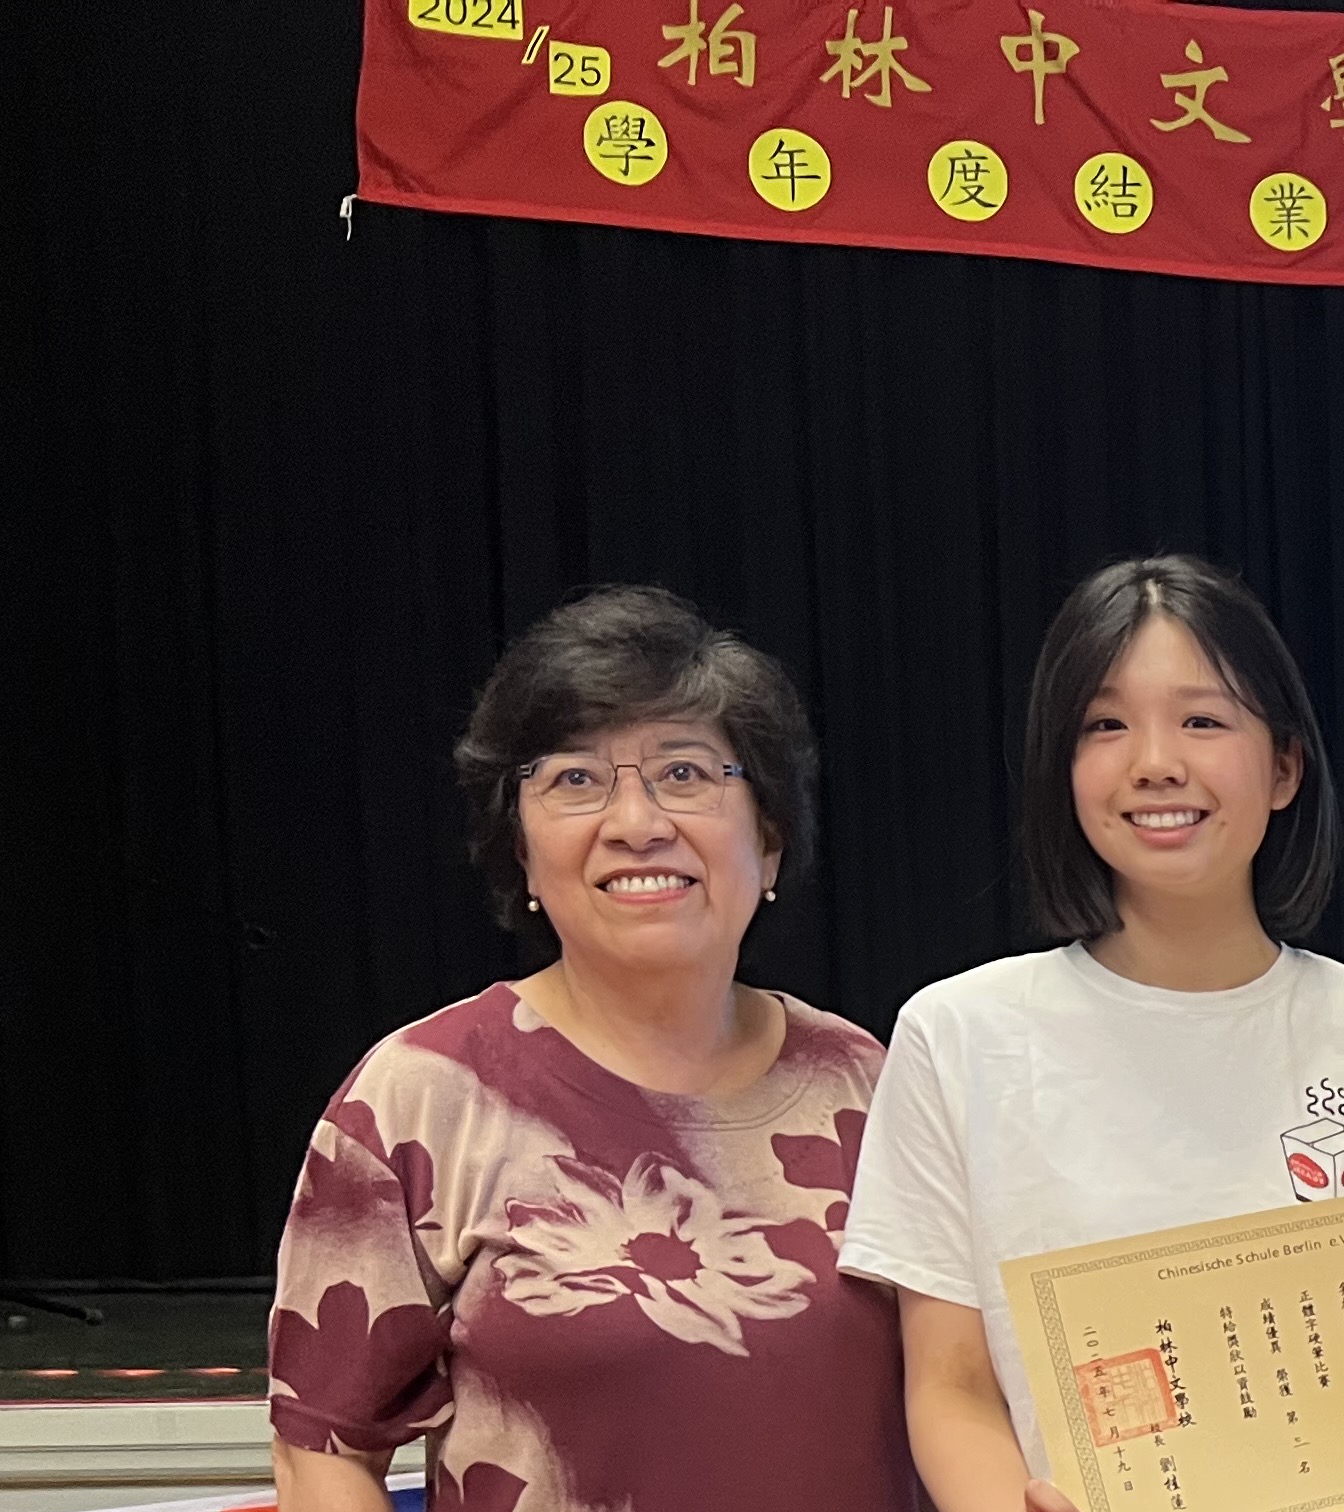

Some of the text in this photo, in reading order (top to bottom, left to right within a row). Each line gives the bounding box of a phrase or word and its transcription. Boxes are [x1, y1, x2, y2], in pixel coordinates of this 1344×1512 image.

[1158, 1257, 1234, 1281] Chinesische
[1235, 1247, 1280, 1266] Schule
[1282, 1239, 1323, 1257] Berlin
[1154, 1318, 1198, 1429] 柏林中文學校
